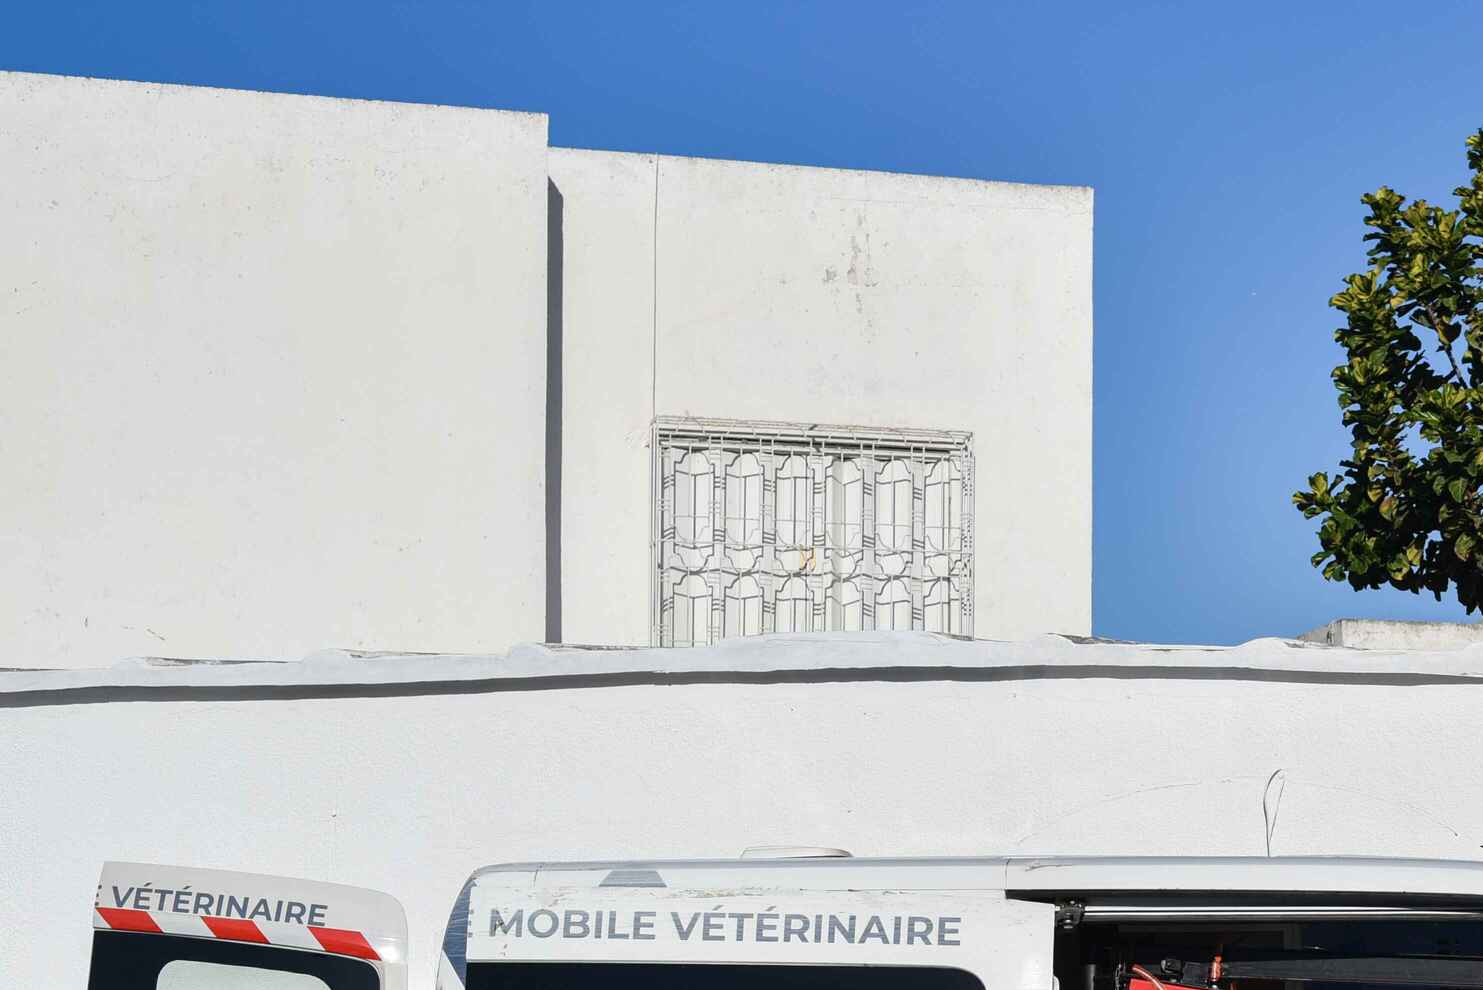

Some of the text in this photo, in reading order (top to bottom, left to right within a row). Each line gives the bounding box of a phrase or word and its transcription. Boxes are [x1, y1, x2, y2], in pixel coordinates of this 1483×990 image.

[111, 883, 329, 927] VÉTÉRINAIRE
[488, 908, 657, 941] MOBILE
[670, 905, 962, 947] VÉTÉRINAIRE
